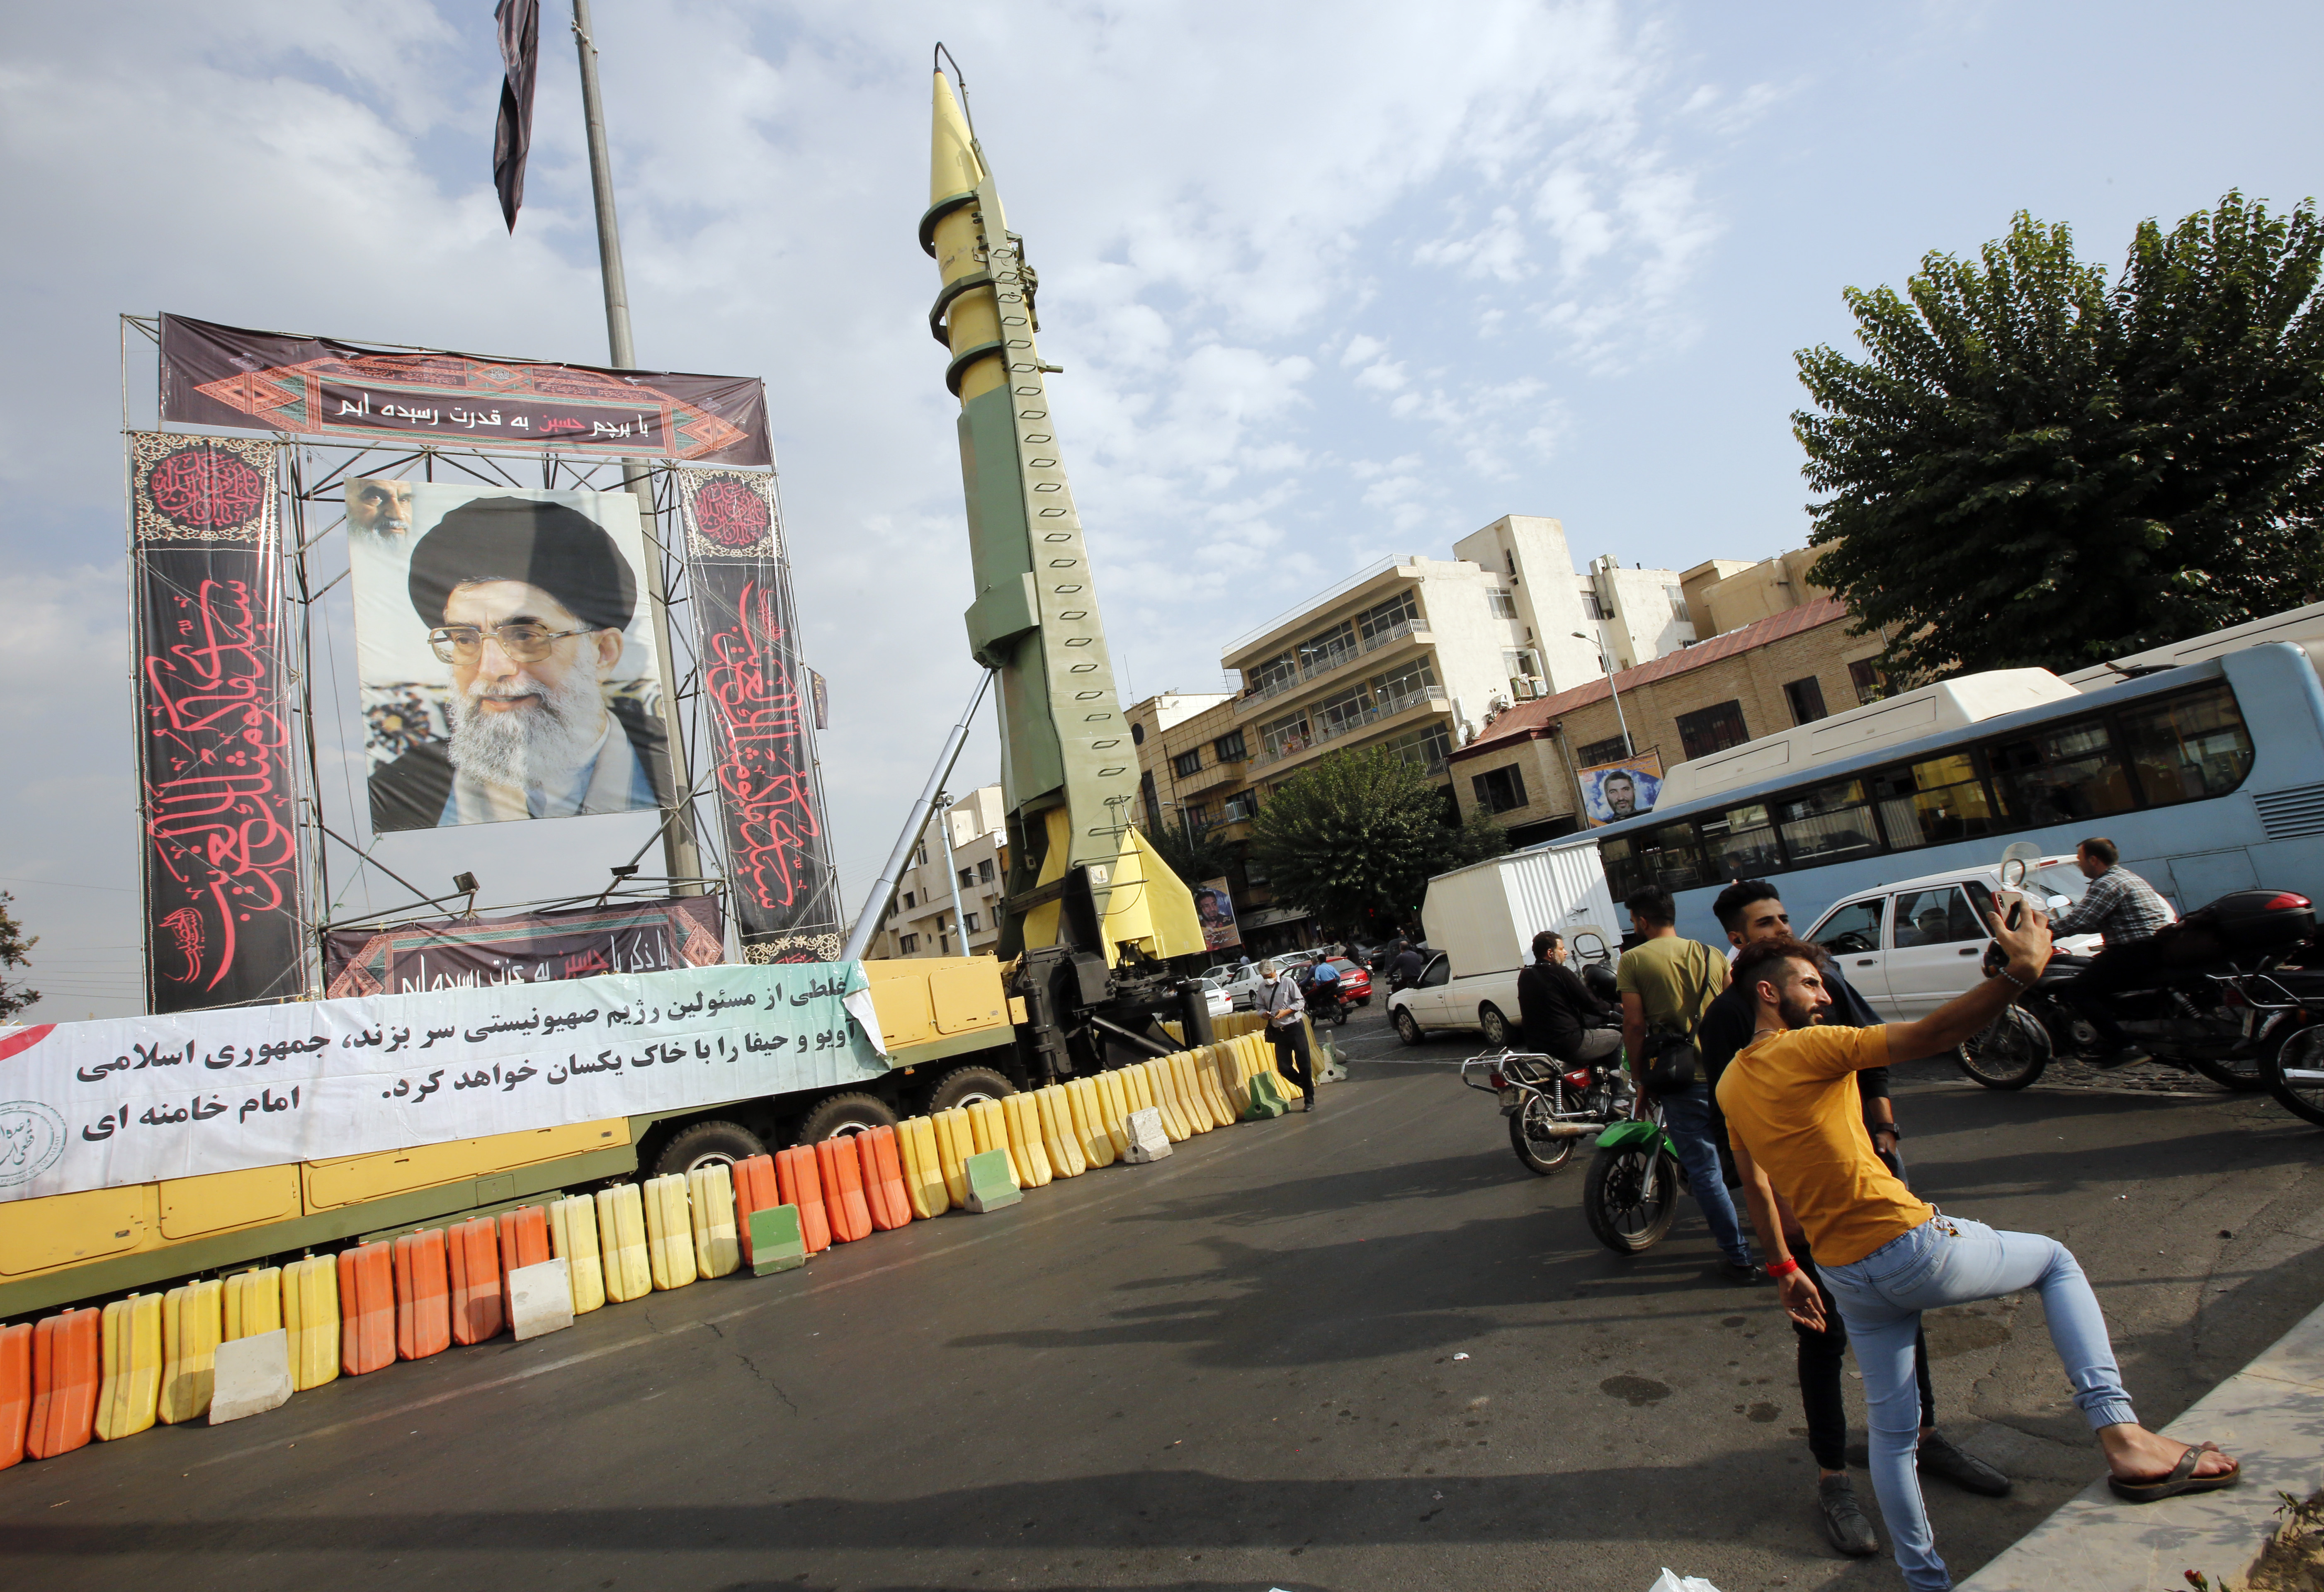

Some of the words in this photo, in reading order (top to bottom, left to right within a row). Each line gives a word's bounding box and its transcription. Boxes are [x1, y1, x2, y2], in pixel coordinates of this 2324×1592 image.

[335, 392, 370, 417] ایم
[381, 404, 439, 426] رسیده
[449, 406, 502, 429] قدرت
[510, 415, 530, 431] به
[539, 414, 586, 433] حسین
[588, 420, 631, 439] پرچم
[638, 414, 649, 438] با
[667, 989, 756, 1021] مسئولین
[764, 982, 782, 1010] از
[790, 977, 846, 1007] غلطی
[464, 1007, 599, 1043] صهیونیستی
[607, 999, 660, 1027] رژیم
[419, 1025, 455, 1048] سر
[717, 1035, 738, 1063] را
[745, 1031, 789, 1056] حیفا
[796, 1035, 808, 1053] و
[76, 1039, 195, 1082] اسلامی
[204, 1034, 332, 1070] جمهوری
[631, 1041, 687, 1068] خاک
[695, 1038, 710, 1065] با
[454, 1058, 538, 1092] خواهد
[547, 1049, 623, 1085] یکسان
[382, 1069, 445, 1104] کرد.
[139, 1093, 229, 1126] خامنه
[239, 1085, 299, 1124] امام
[82, 1103, 129, 1141] ای
[1, 1168, 36, 1182] PROMISE
[49, 1136, 61, 1158] ALLAH
